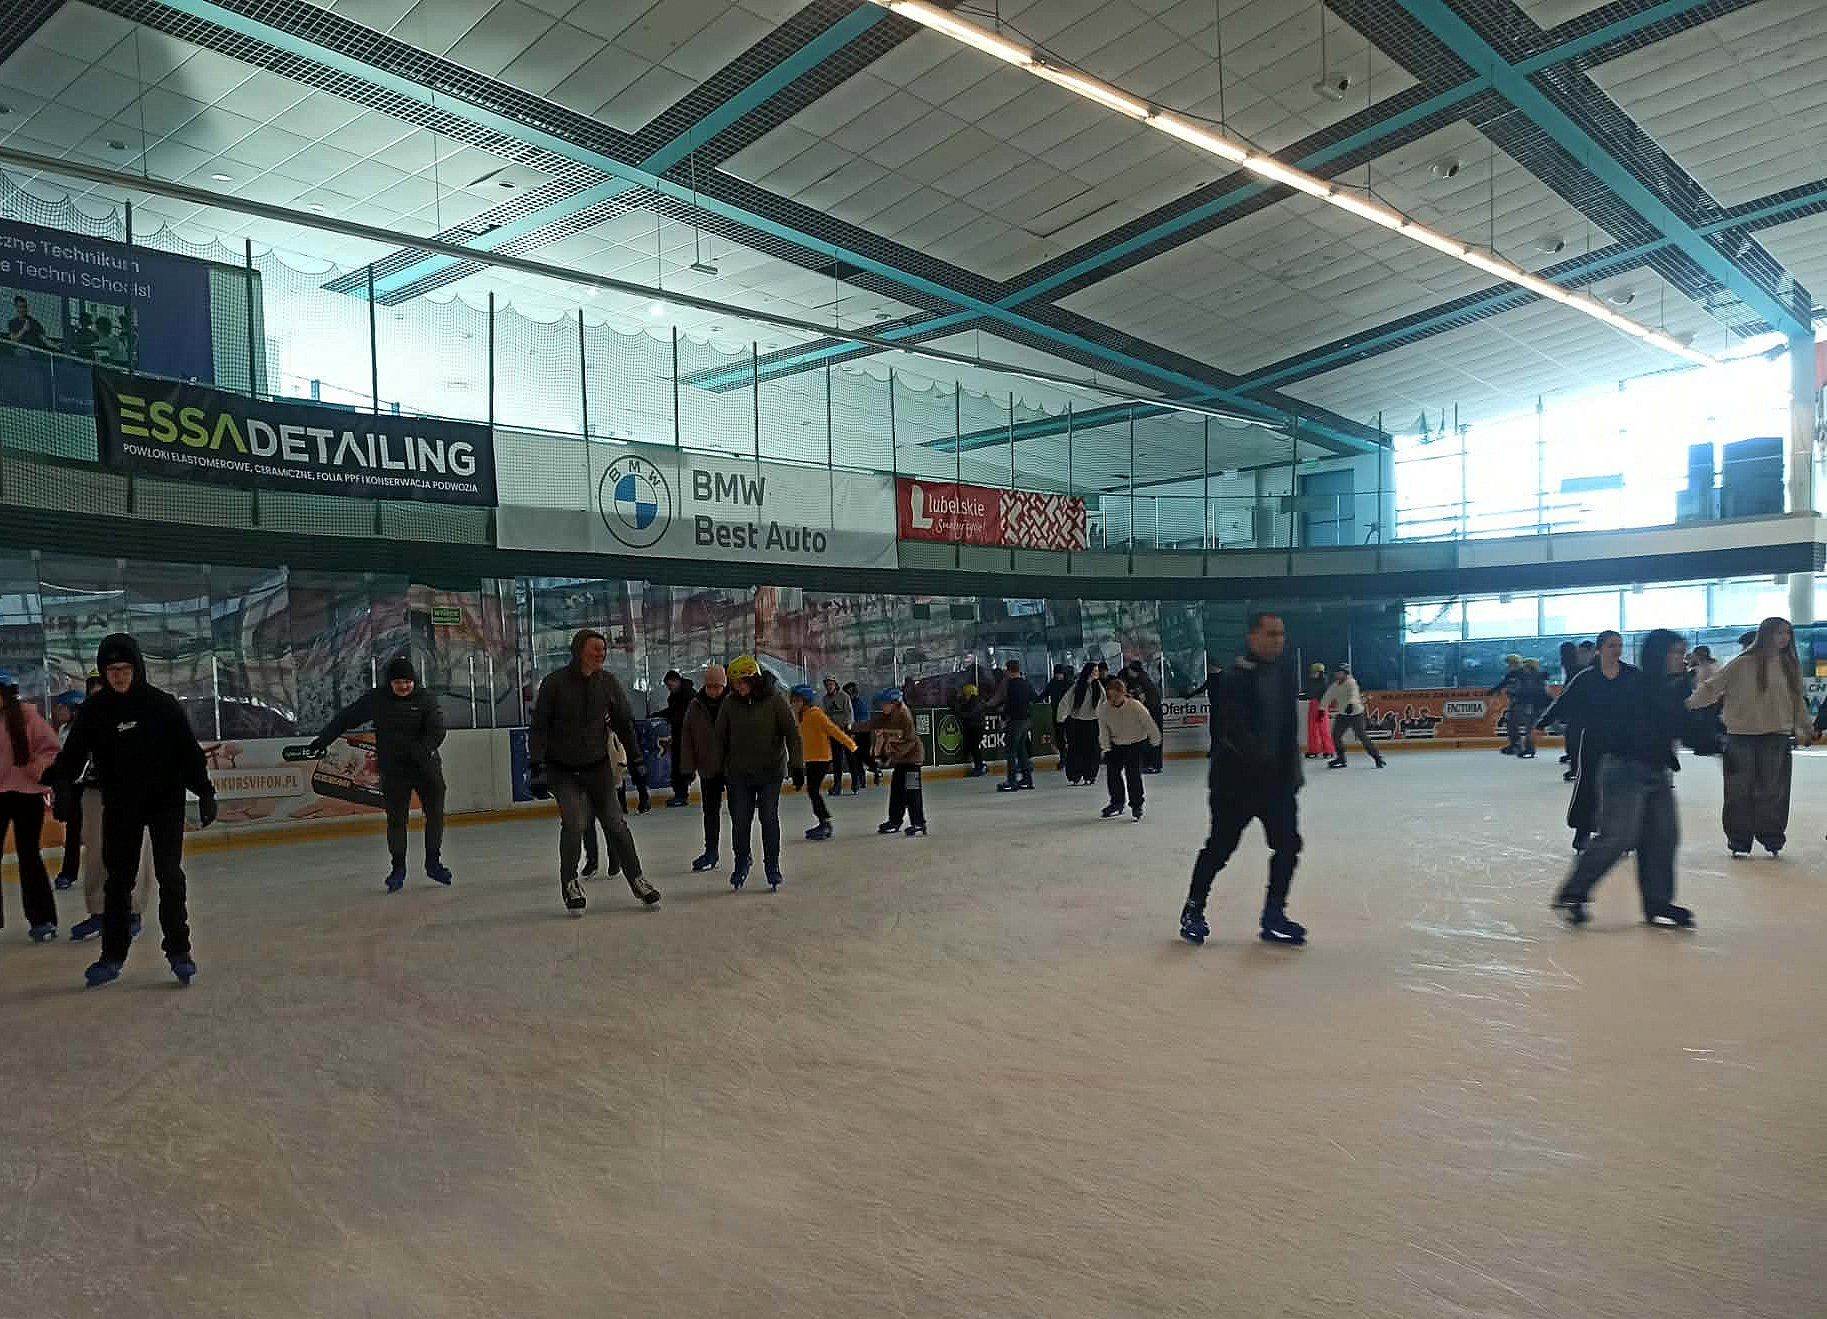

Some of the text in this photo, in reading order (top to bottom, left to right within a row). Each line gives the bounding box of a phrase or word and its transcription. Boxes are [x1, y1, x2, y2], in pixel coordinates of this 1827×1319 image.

[0, 235, 140, 273] zne Technikum
[15, 260, 76, 285] Techni
[366, 476, 431, 489] KONSERWACJA
[432, 480, 478, 493] PODWOZIA
[692, 469, 767, 506] BMW
[694, 514, 827, 553] Best Auto
[1161, 703, 1197, 715] Oferta
